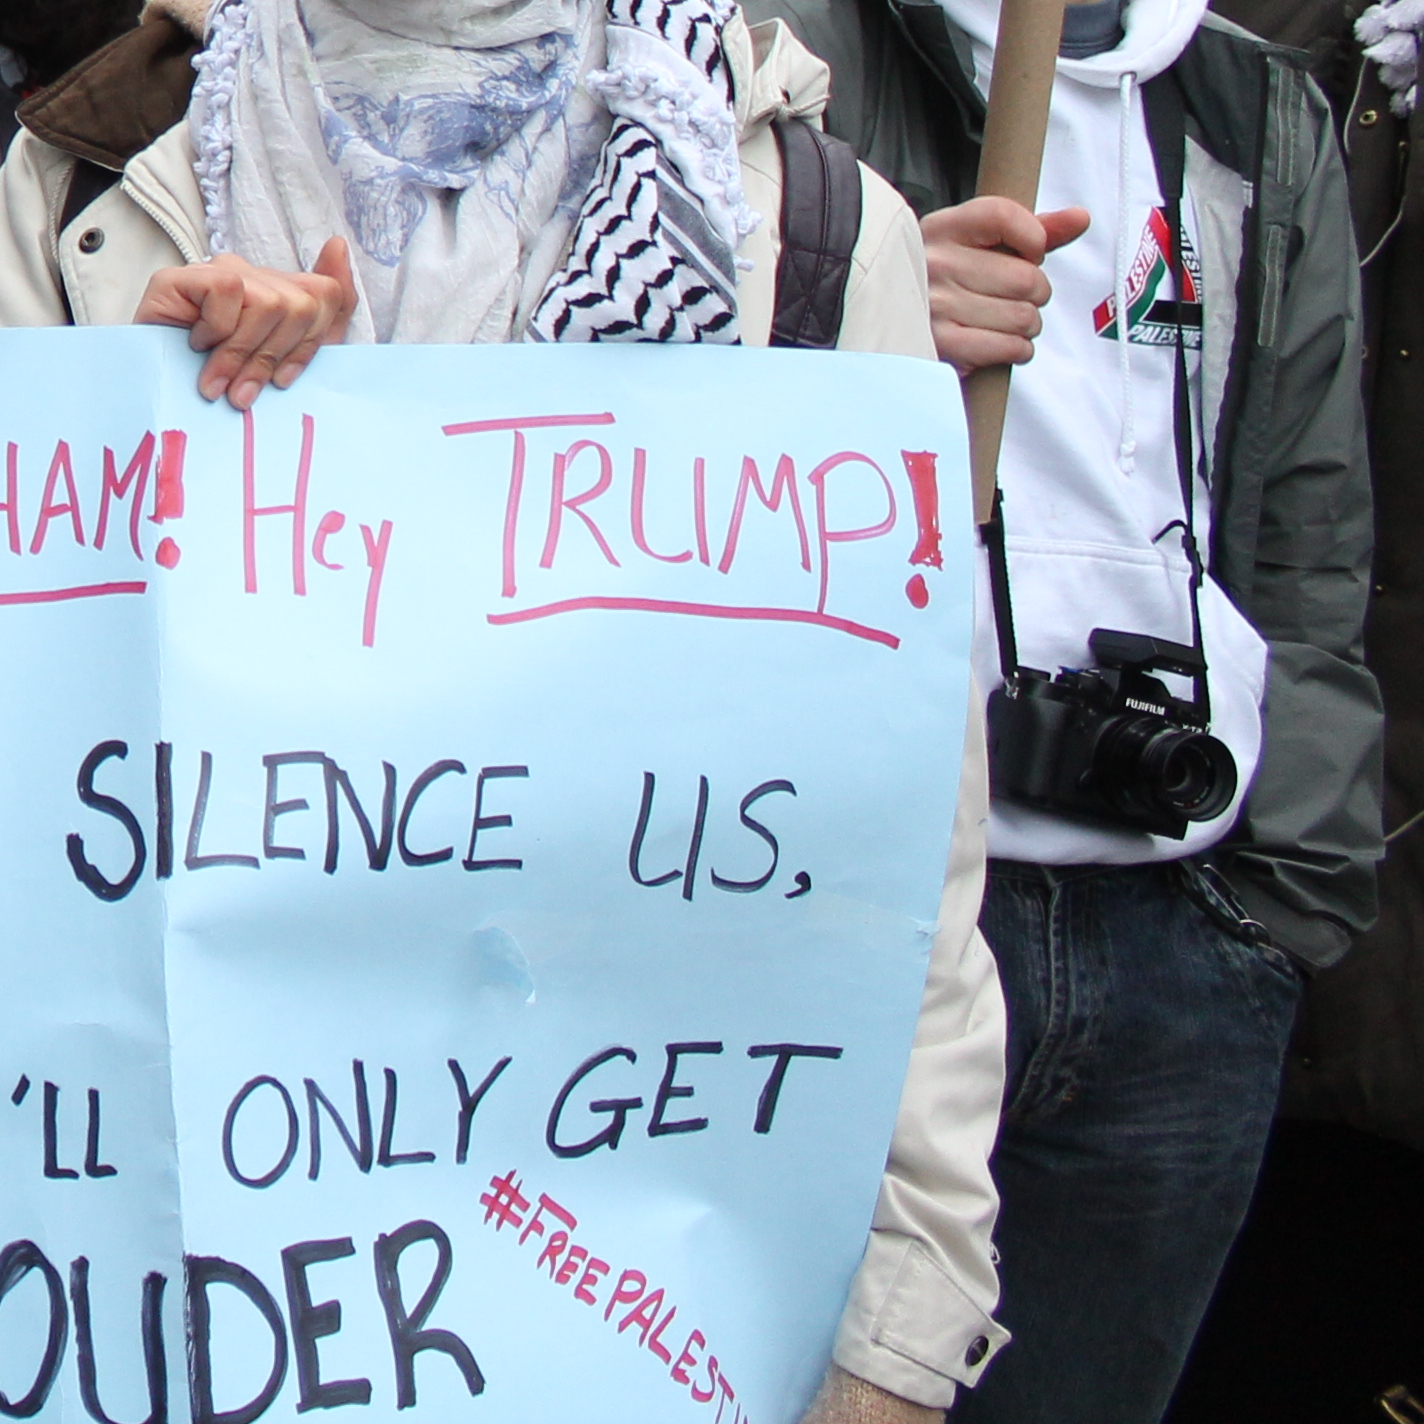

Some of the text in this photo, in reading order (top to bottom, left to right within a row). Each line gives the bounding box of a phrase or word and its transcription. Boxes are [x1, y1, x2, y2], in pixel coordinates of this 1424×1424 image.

[1106, 225, 1159, 318] PLESTINE
[1127, 324, 1202, 348] PALESINE
[242, 409, 943, 648] Hey TRUMP!
[1125, 697, 1166, 716] FUJIFILM
[65, 739, 530, 902] SILENCE
[629, 770, 812, 902] US,
[221, 1054, 513, 1190] ONLY
[545, 1040, 845, 1160] GET
